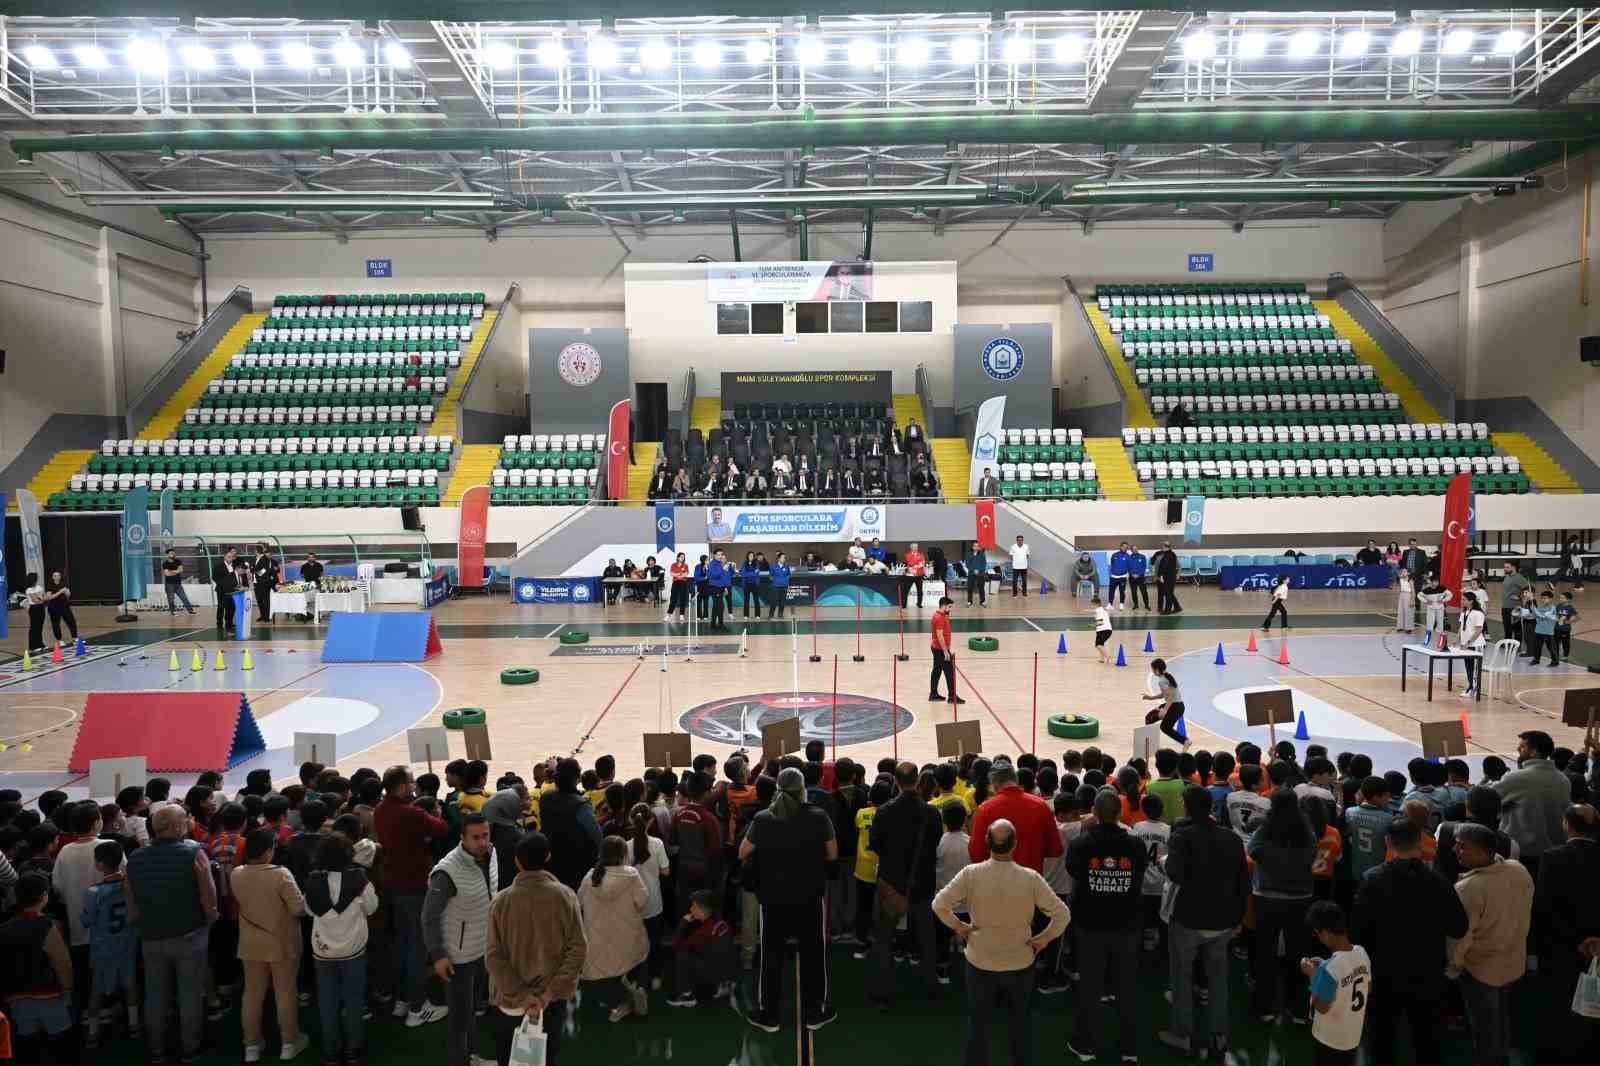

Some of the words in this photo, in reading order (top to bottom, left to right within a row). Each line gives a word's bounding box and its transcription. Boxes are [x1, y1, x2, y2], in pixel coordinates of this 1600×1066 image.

[815, 374, 833, 382] SPOR
[770, 514, 833, 522] SPORCULARA
[743, 524, 798, 533] BAŞARILAR
[1239, 573, 1279, 587] STAG
[1325, 573, 1368, 587] STAG
[1358, 827, 1373, 853] 5
[1088, 869, 1132, 877] KYOKUSHIN
[1088, 876, 1132, 885] KARATE
[1090, 884, 1131, 893] TURKEY
[109, 901, 125, 935] 5
[1351, 975, 1364, 1012] 5
